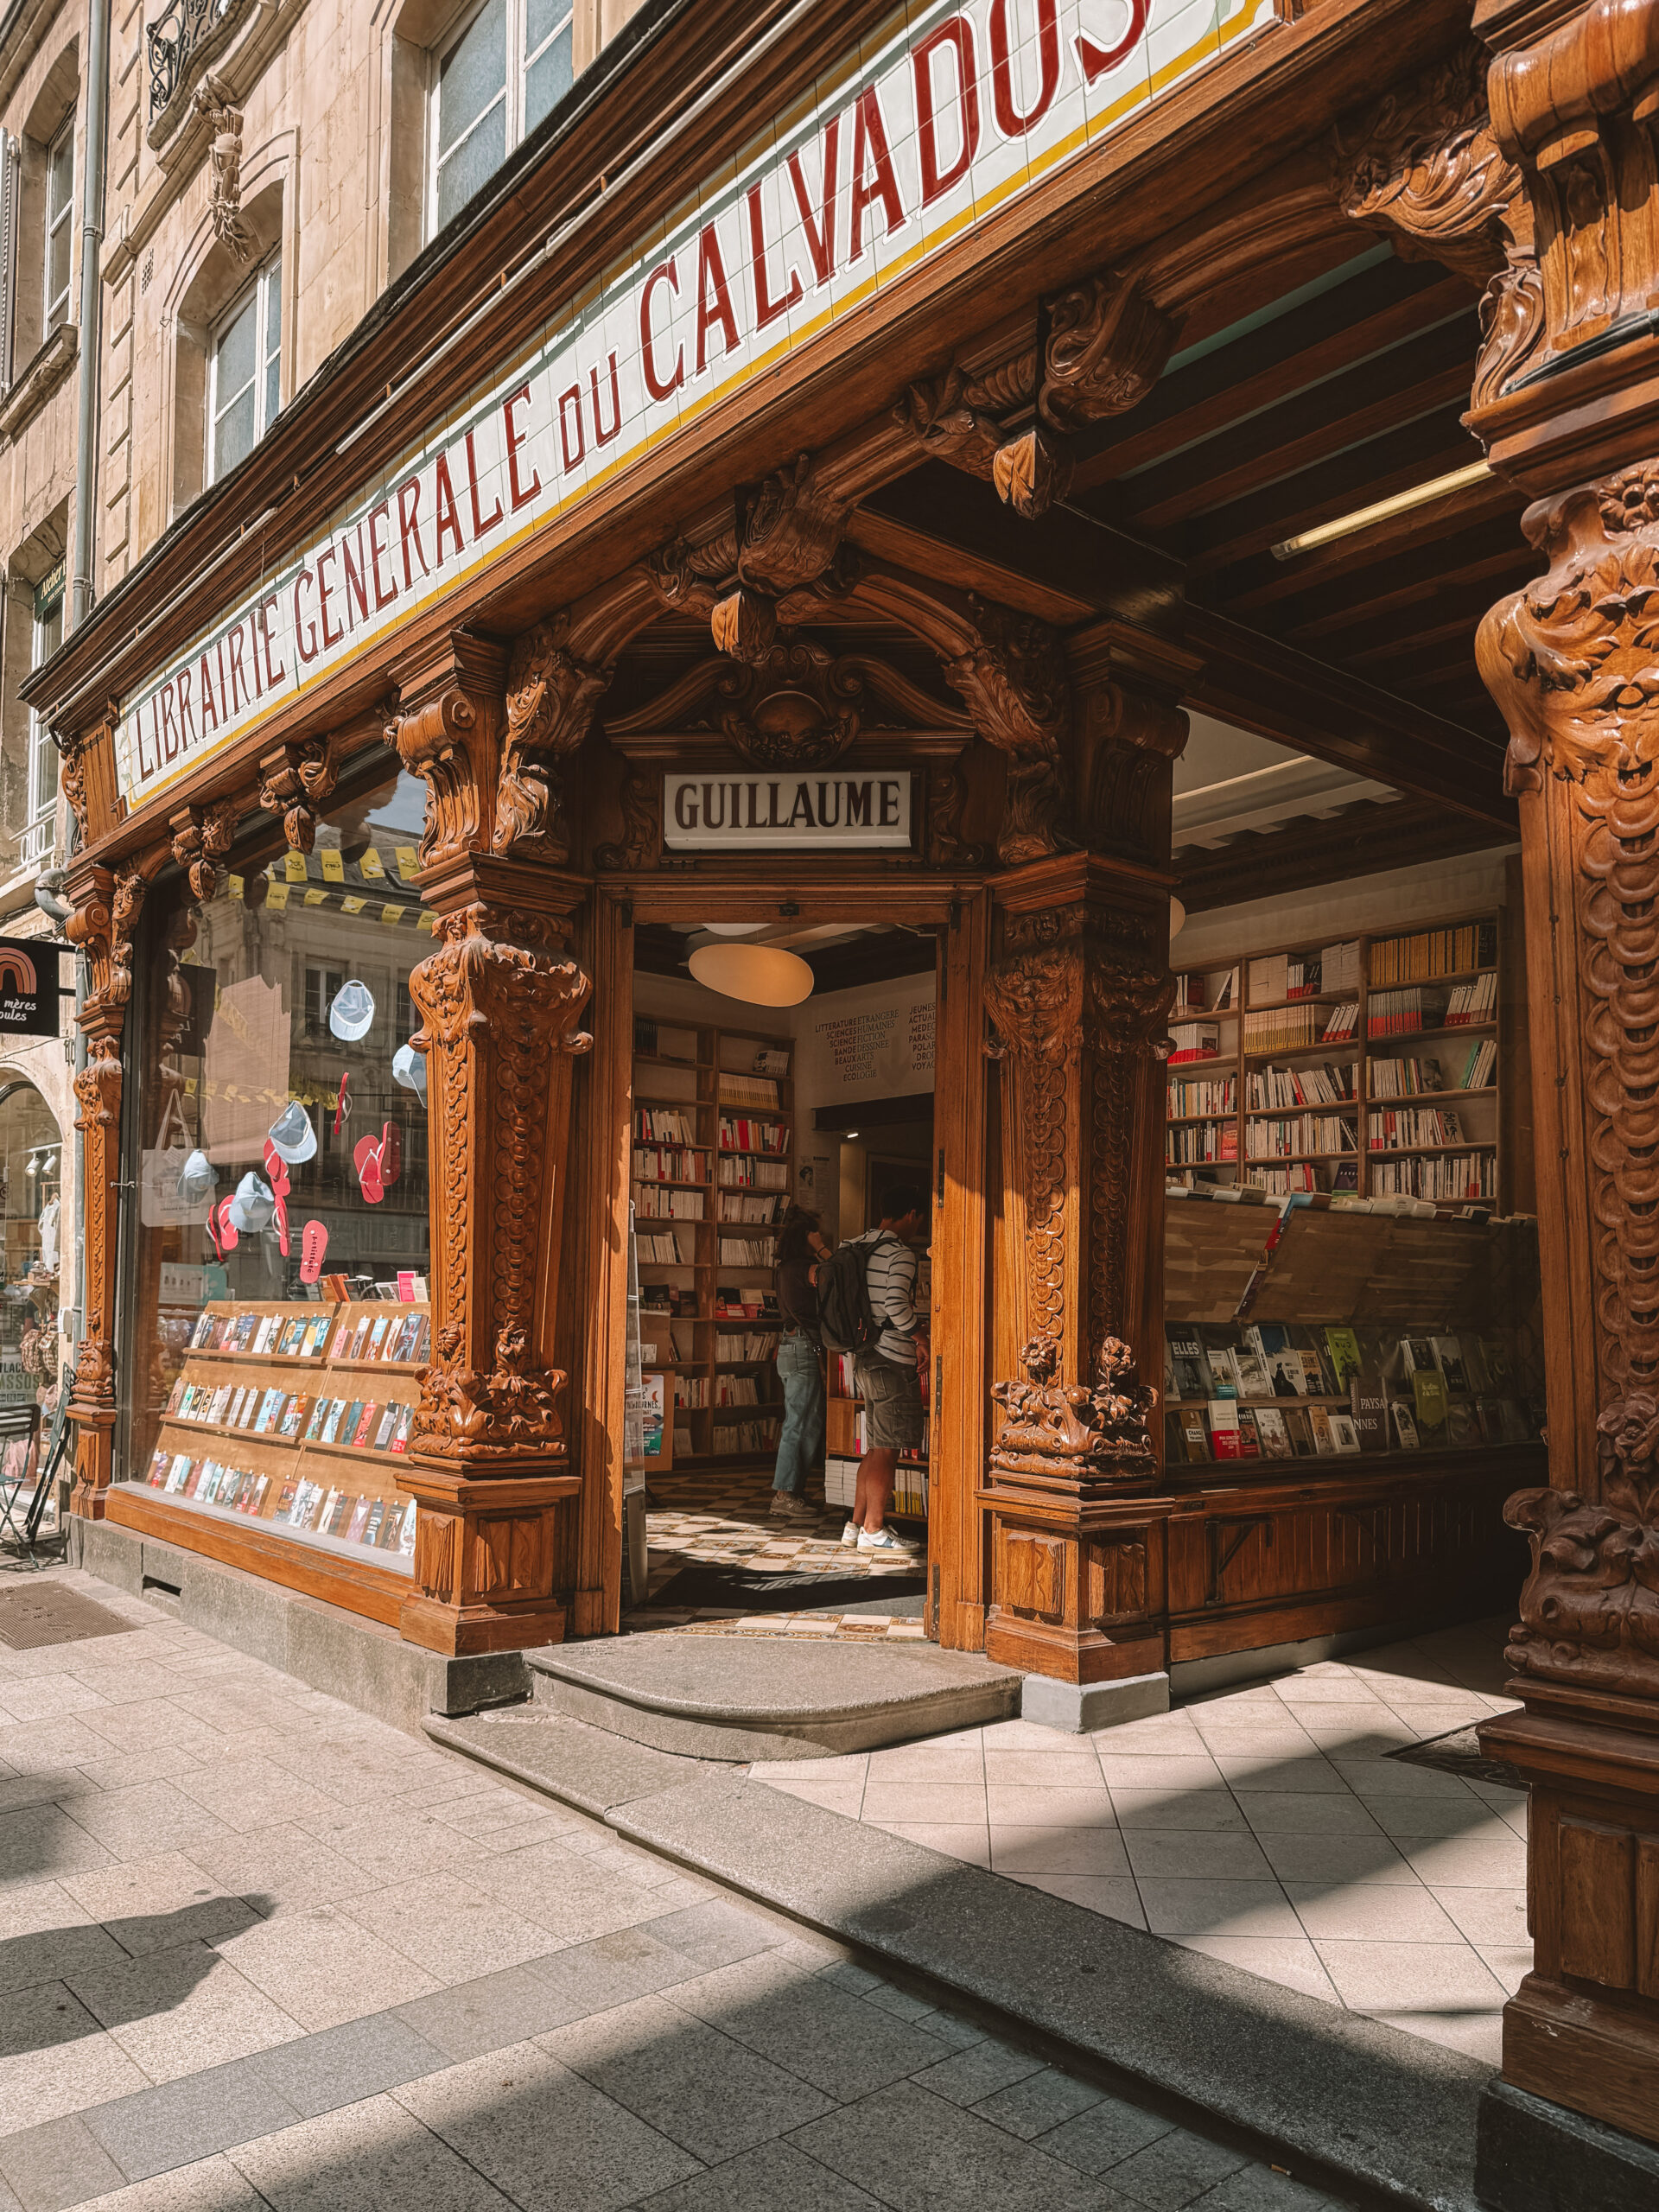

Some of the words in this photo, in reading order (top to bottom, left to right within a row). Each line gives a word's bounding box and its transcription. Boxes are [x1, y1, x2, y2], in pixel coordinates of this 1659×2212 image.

[135, 594, 286, 783] LIBRAIRIE
[294, 380, 542, 664] GENERALE
[557, 349, 622, 477] DU
[674, 780, 900, 830] GUILLAUME
[3, 998, 37, 1011] mères
[815, 1017, 856, 1033] LITTERATURE
[857, 1009, 899, 1025] ETRANGERE
[826, 1027, 856, 1039] SCIENCES
[857, 1020, 895, 1034] HUMAINES
[829, 1036, 856, 1048] SCIENCE
[857, 1031, 886, 1043] FICTION
[834, 1046, 856, 1057] BANDE
[857, 1039, 889, 1052] DESSINEE
[835, 1054, 856, 1065] BEAUX
[857, 1051, 874, 1062] ARTS
[845, 1061, 872, 1072] CUISINE
[843, 1070, 877, 1082] ECOLOGIE
